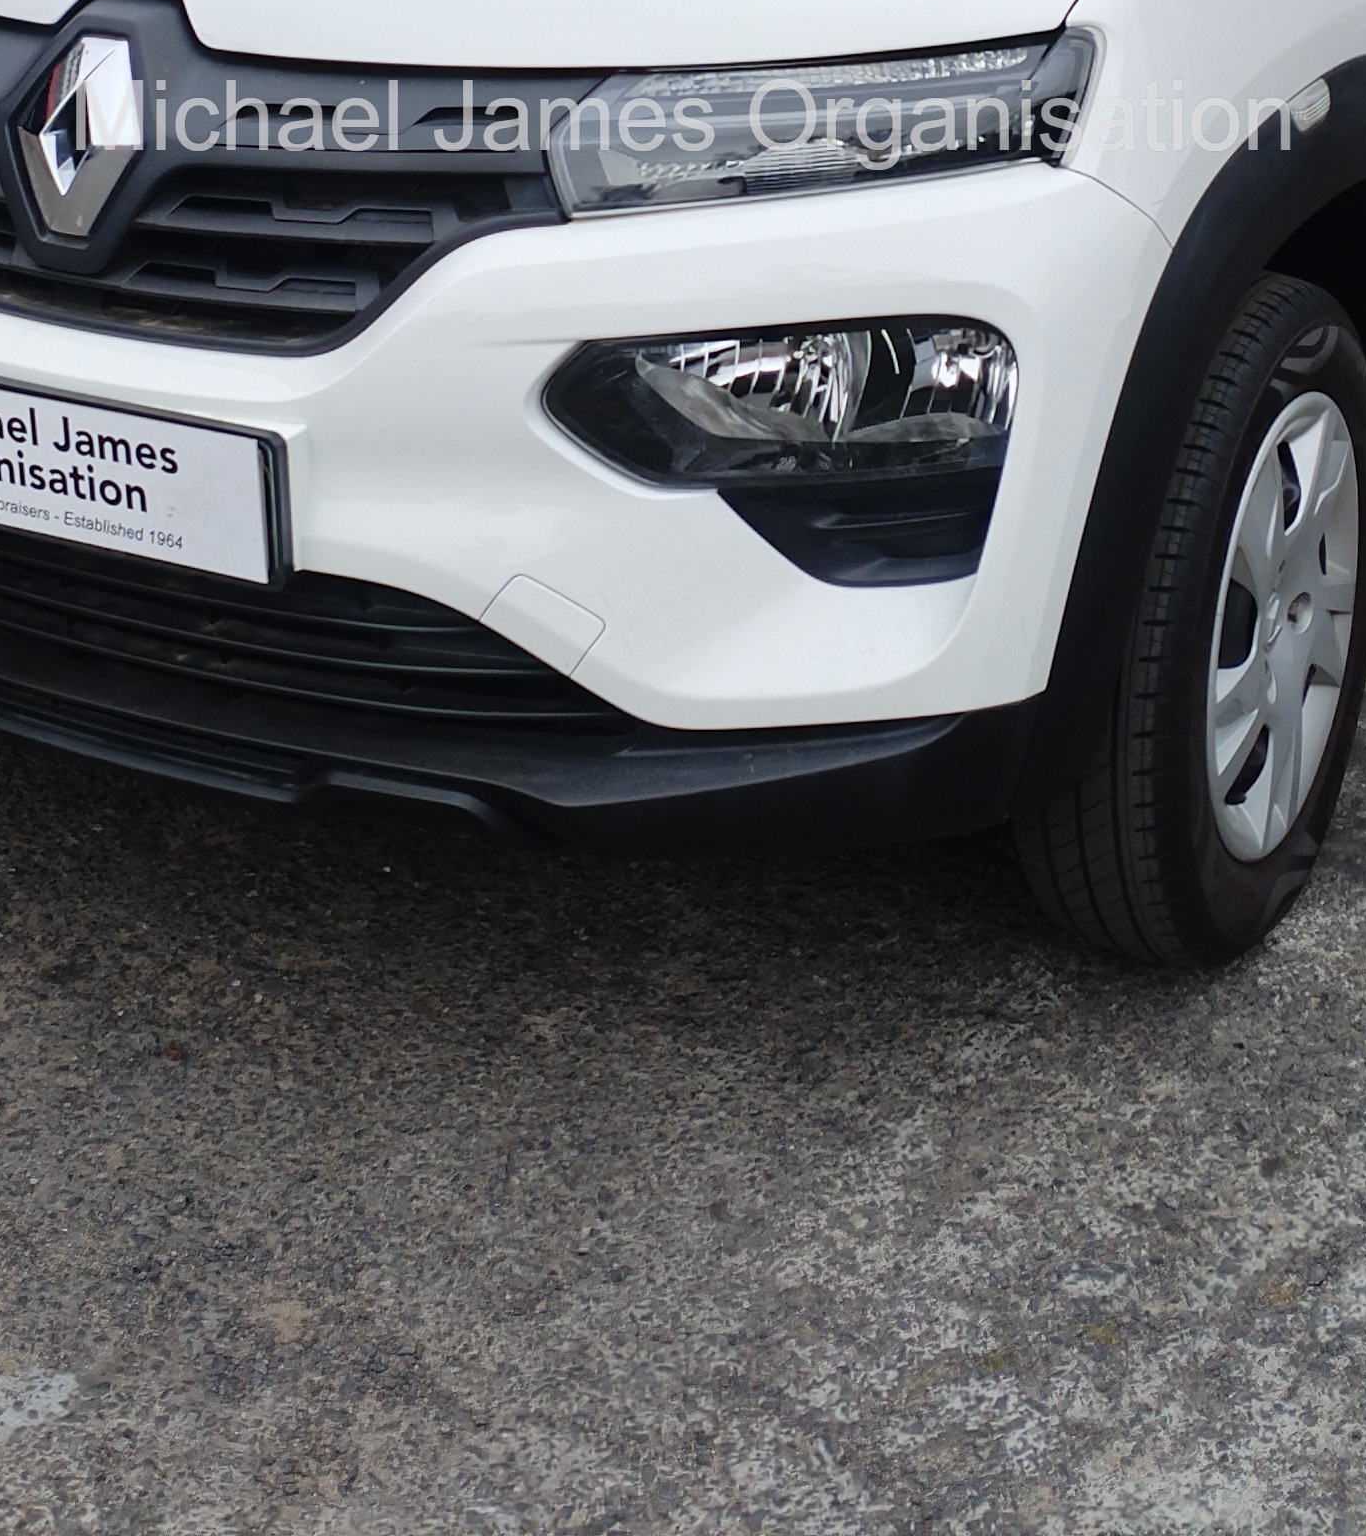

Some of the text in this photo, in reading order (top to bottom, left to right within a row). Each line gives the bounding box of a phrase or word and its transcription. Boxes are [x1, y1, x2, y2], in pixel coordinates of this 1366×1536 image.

[53, 416, 179, 474] James
[64, 511, 144, 541] Established
[149, 530, 183, 550] 1964
